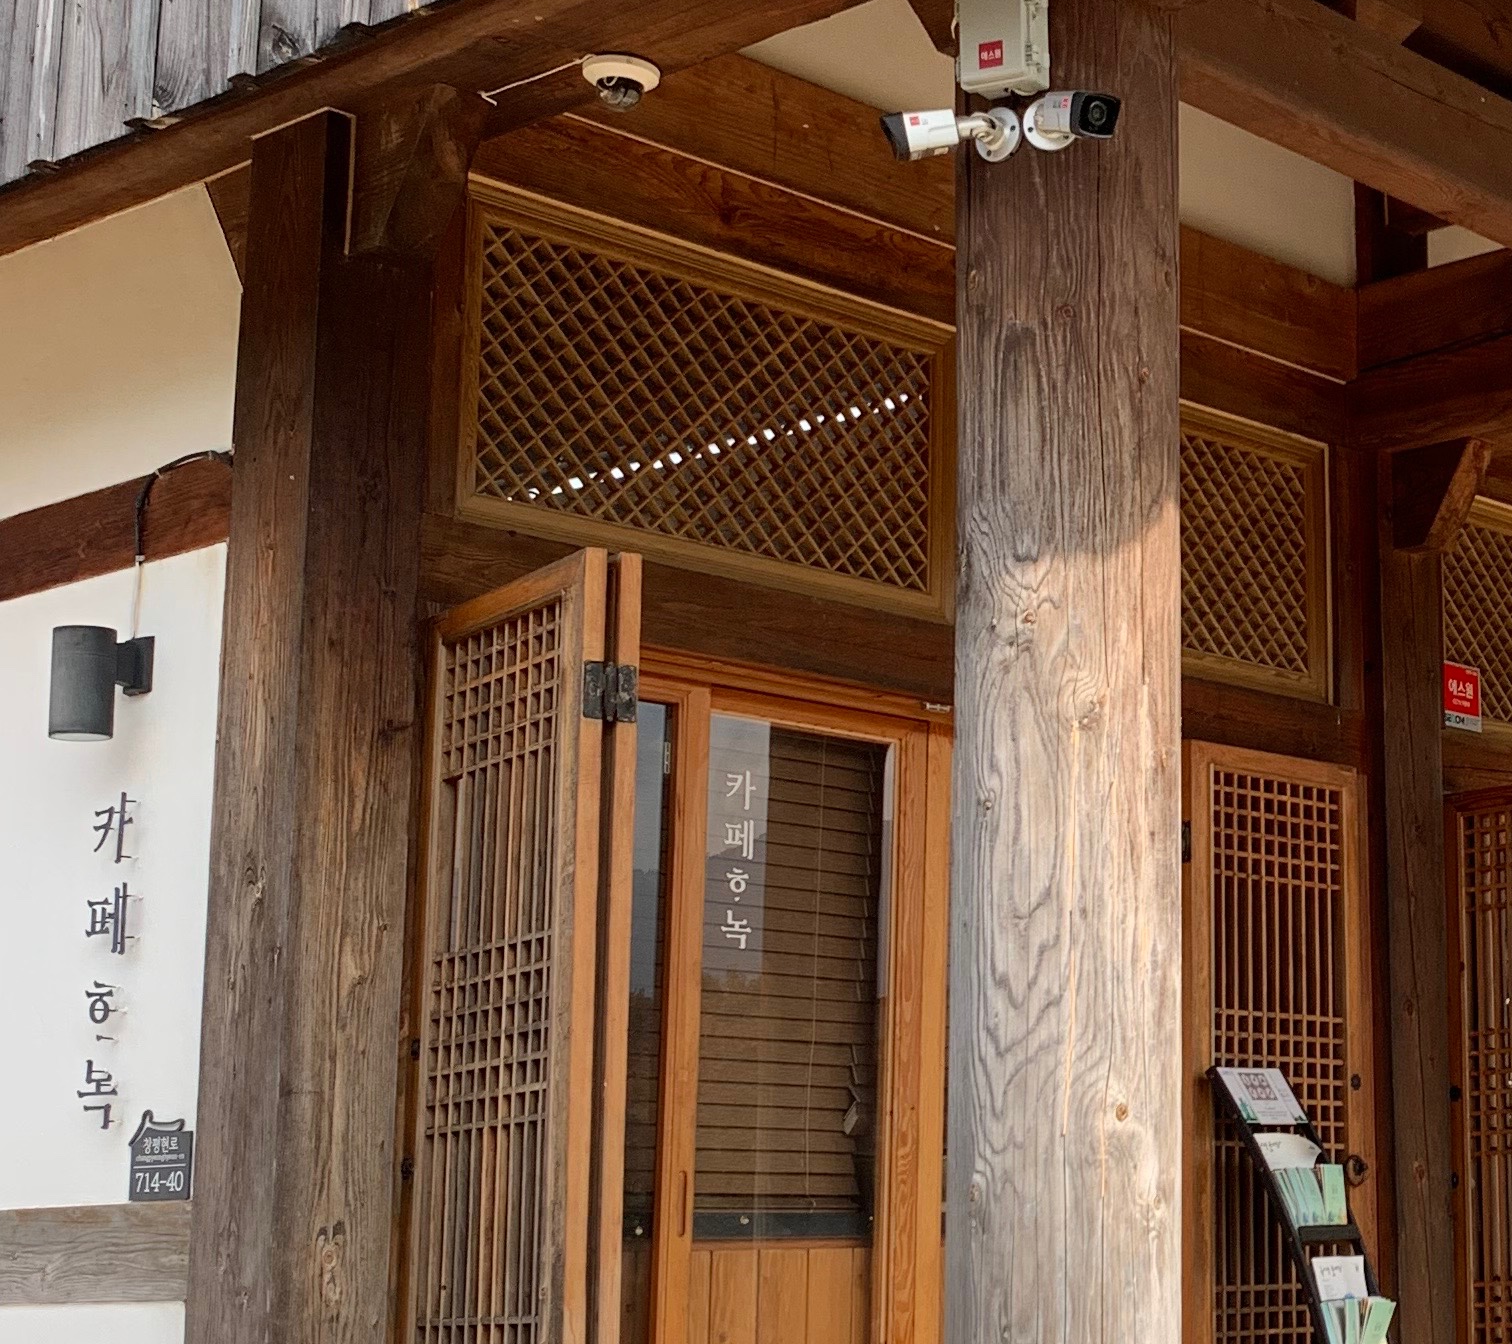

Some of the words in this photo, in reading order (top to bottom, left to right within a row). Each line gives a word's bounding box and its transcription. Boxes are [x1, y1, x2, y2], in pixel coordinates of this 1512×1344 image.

[1448, 678, 1474, 700] 에스원
[143, 1136, 179, 1154] 창평현로
[135, 1170, 184, 1193] 714-40
